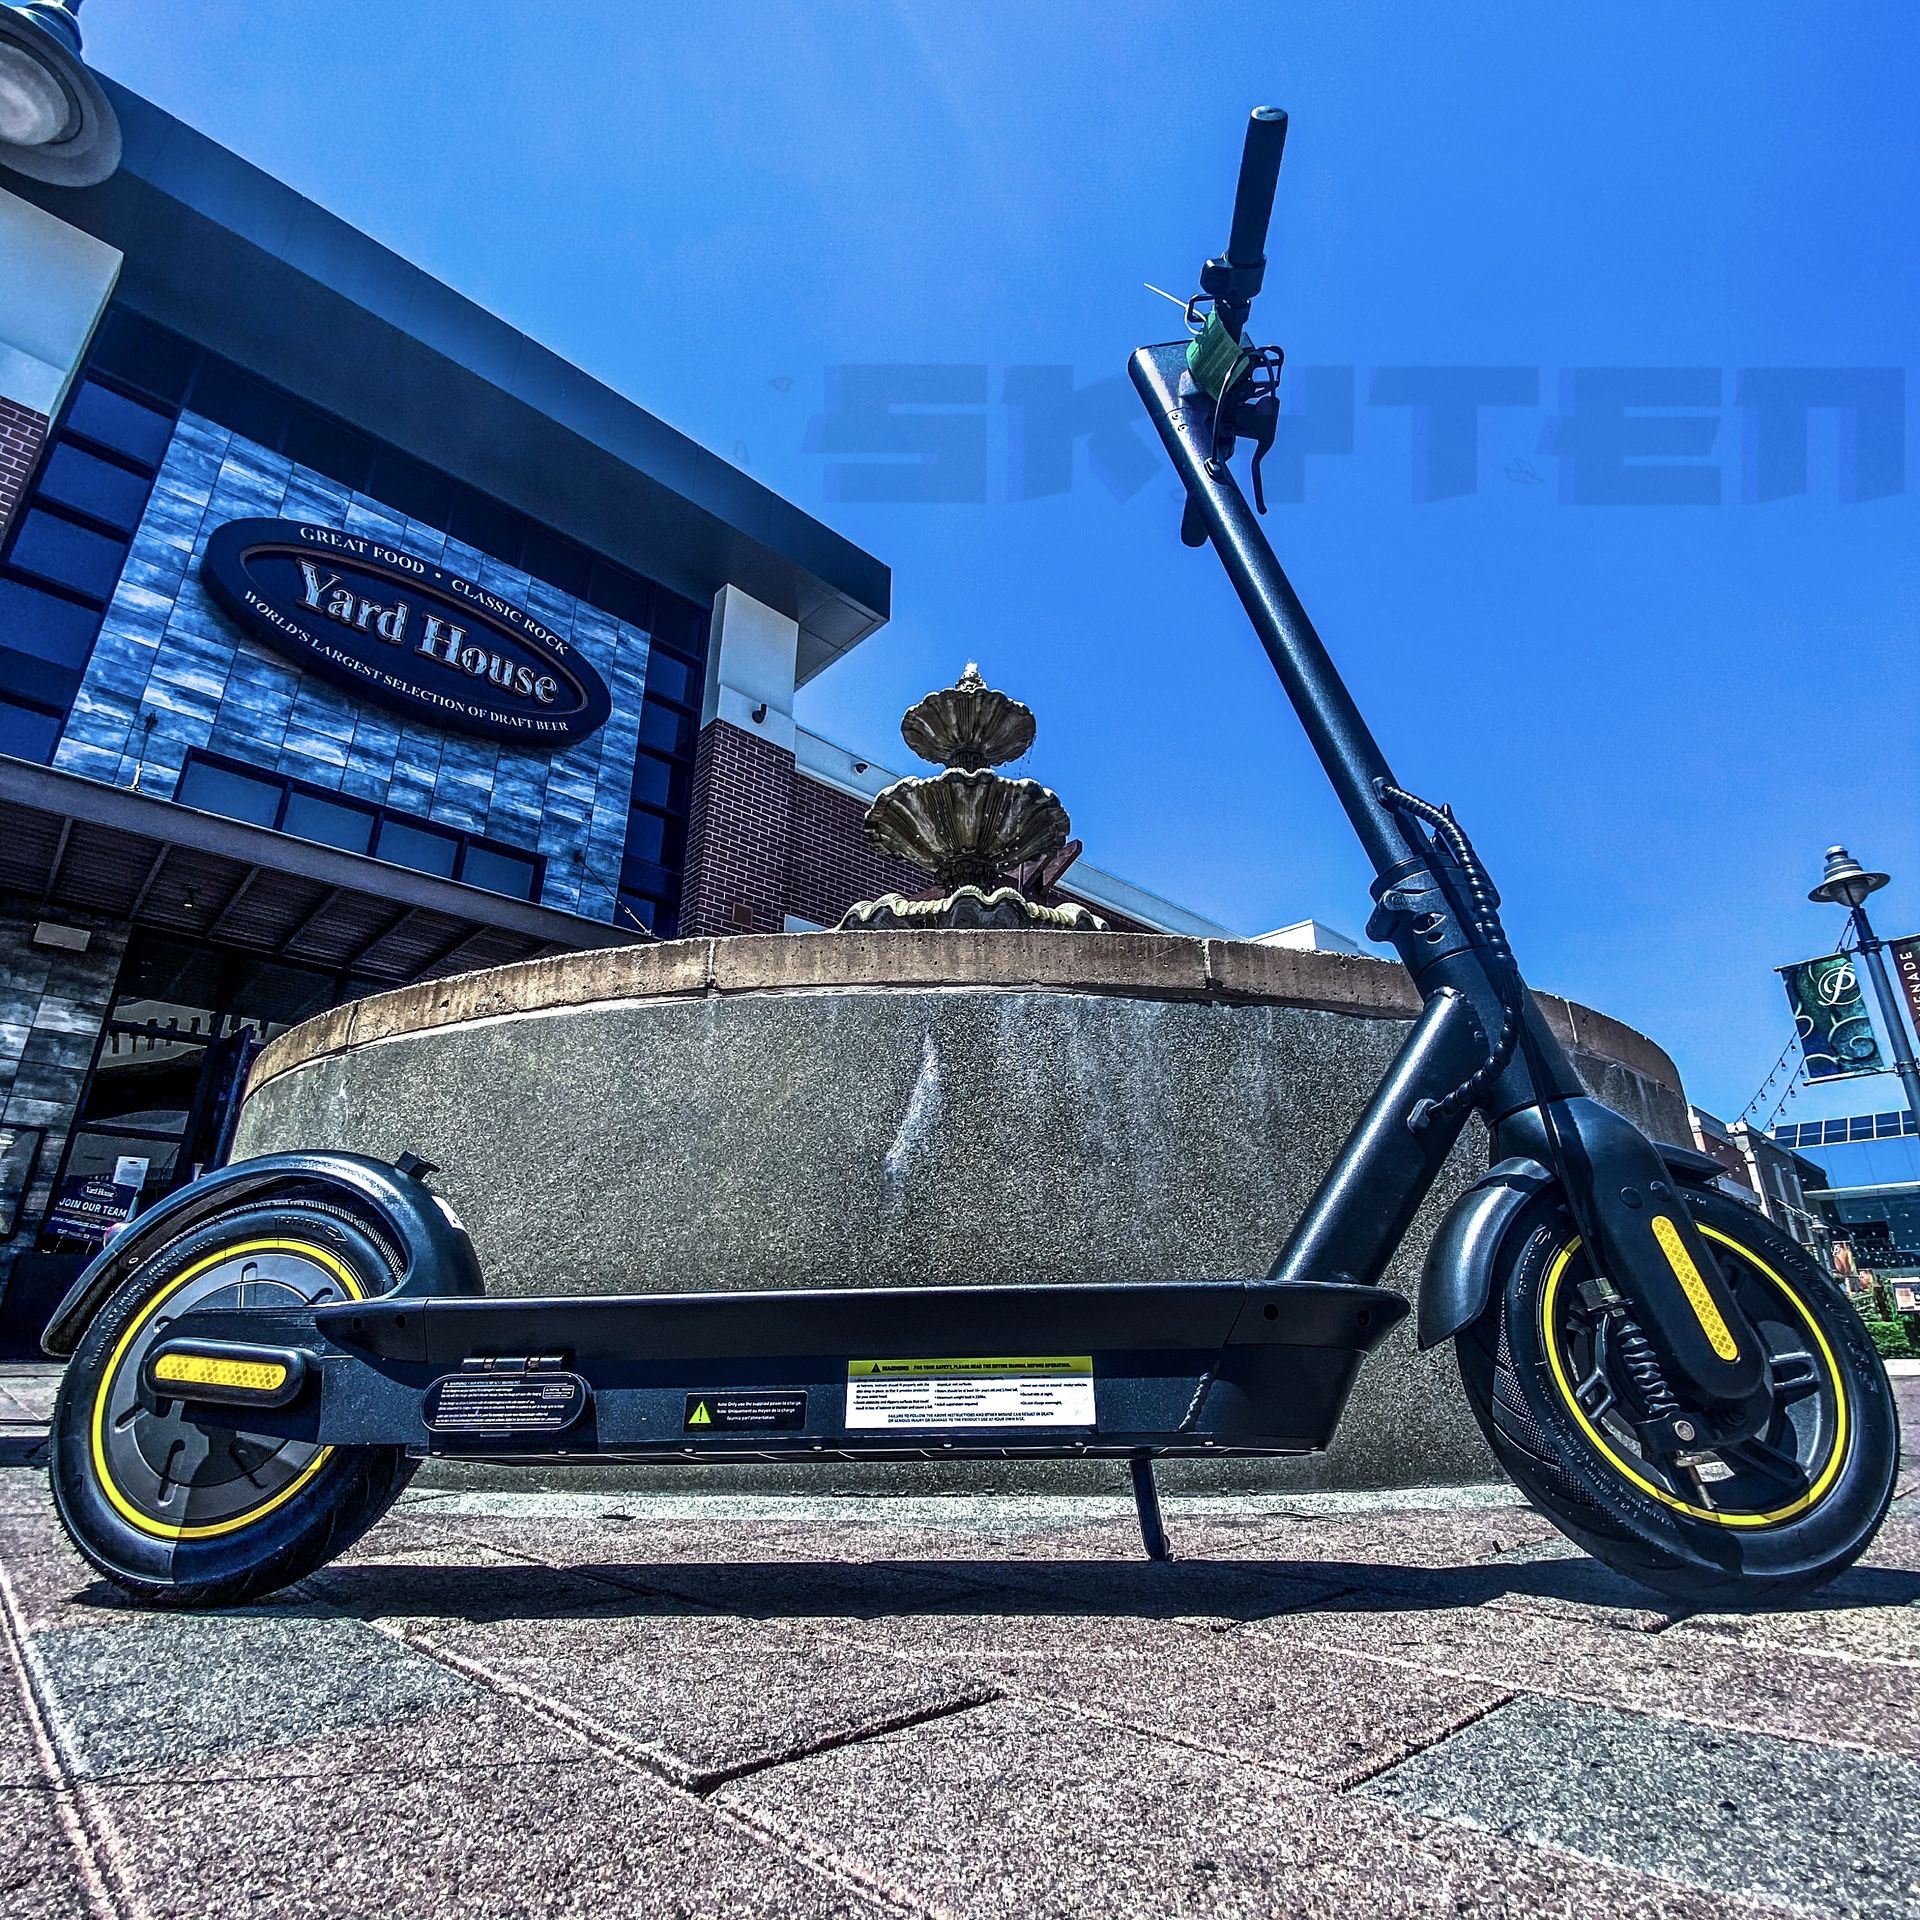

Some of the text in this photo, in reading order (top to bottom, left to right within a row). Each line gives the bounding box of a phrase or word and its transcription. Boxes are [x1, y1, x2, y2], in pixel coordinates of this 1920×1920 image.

[300, 526, 425, 574] GREAT FOOD
[297, 556, 559, 705] Yard House
[451, 579, 569, 656] CLASSIC ROCK
[244, 590, 569, 732] WORLD'S LARGEST SELECTION OF DRAFT BEER
[1899, 951, 1920, 1017] ENADE
[59, 1197, 127, 1218] JOIN OUR TEAM
